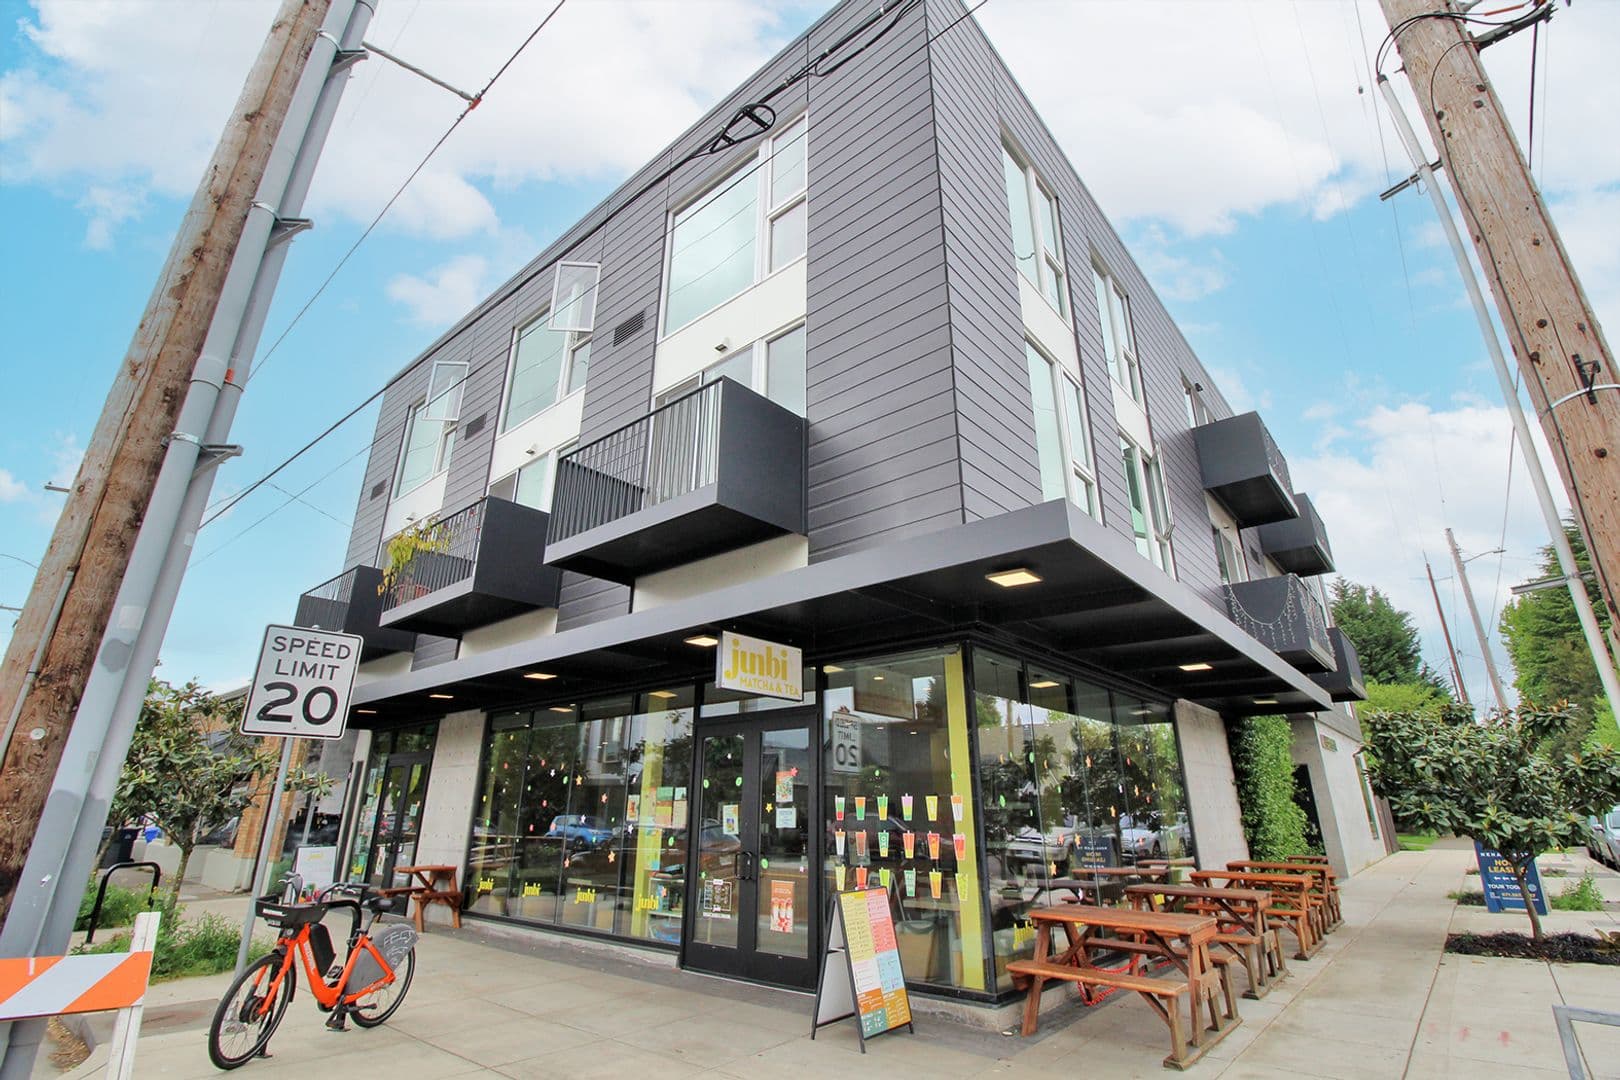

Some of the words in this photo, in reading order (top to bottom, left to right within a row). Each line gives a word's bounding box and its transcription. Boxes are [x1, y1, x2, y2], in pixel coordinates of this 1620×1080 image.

[272, 636, 351, 660] SPEED
[724, 638, 788, 681] junbi
[275, 659, 340, 681] LIMIT
[740, 677, 775, 692] MATCHA
[775, 682, 783, 694] &
[784, 683, 800, 696] TEA
[256, 681, 338, 726] 20
[1494, 859, 1513, 867] NO
